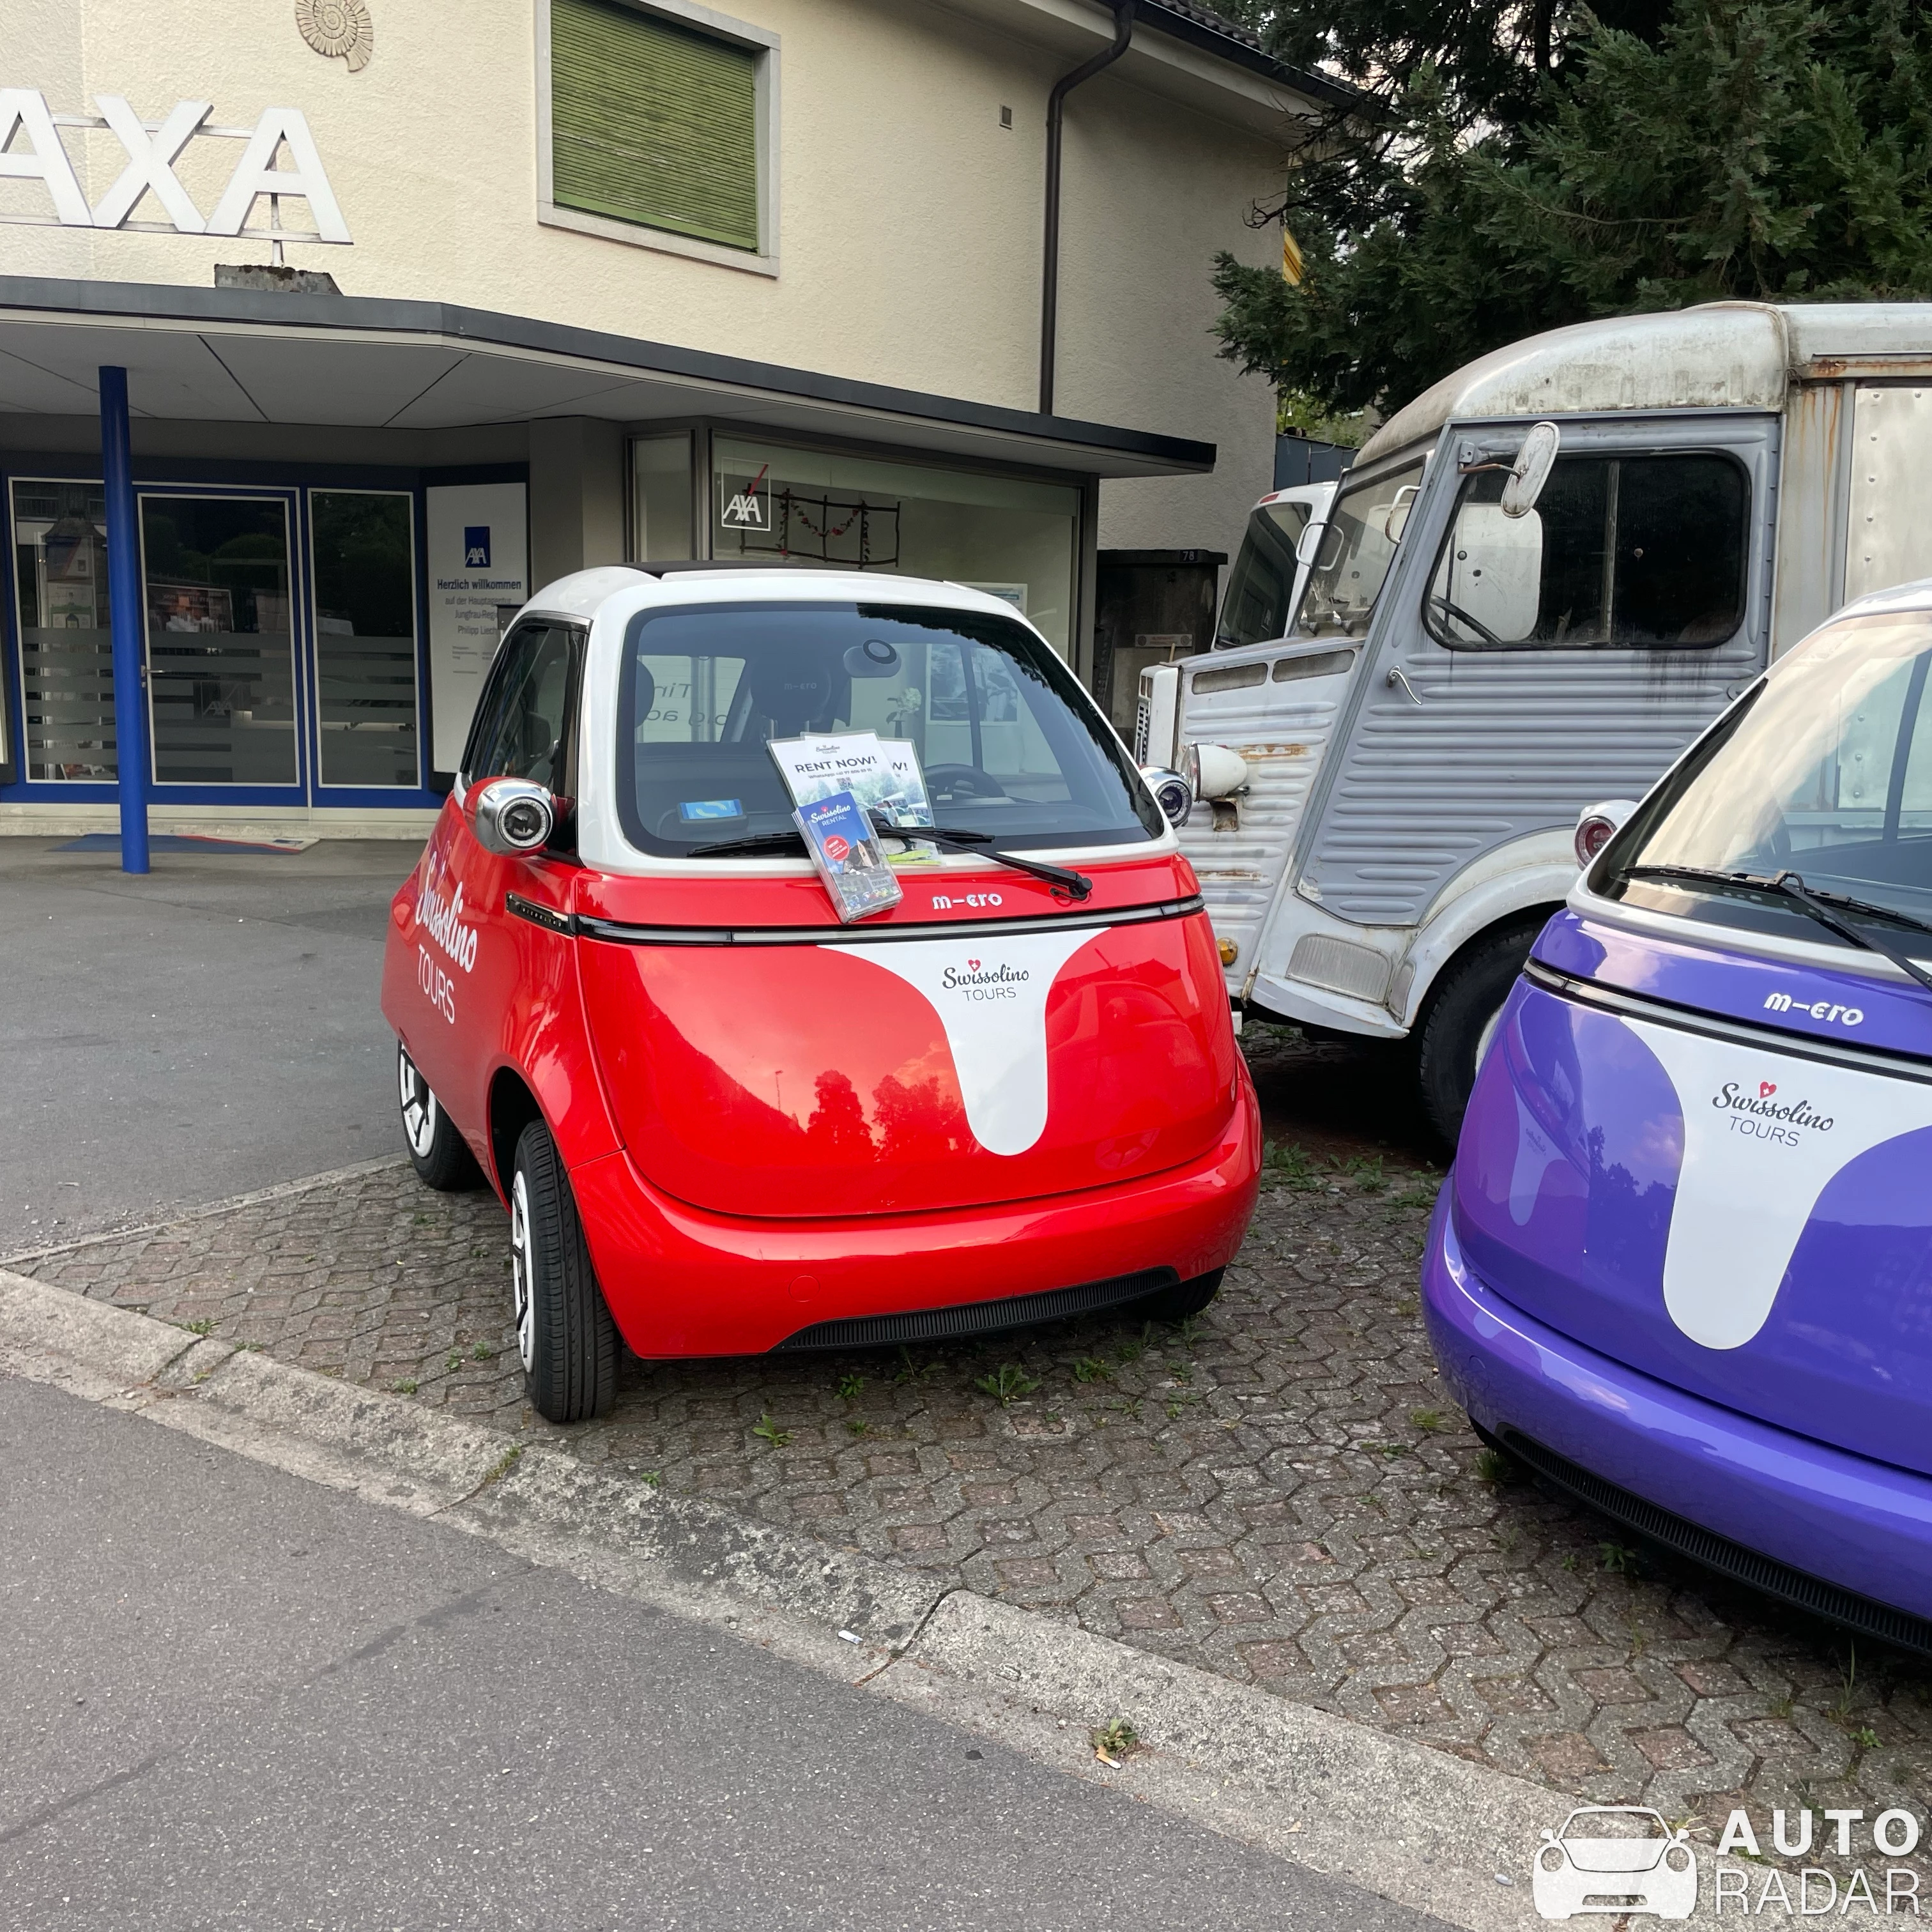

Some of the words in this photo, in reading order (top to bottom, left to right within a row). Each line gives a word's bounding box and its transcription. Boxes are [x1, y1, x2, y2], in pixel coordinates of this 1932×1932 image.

[0, 88, 353, 245] AXA
[723, 494, 762, 523] AXA
[465, 548, 487, 564] AXA
[1183, 551, 1195, 561] 78
[437, 579, 469, 590] Herzlich
[471, 579, 521, 590] willkommen
[794, 761, 832, 773] RENT
[835, 756, 878, 769] NOW!
[811, 804, 851, 824] Swissolino
[822, 815, 847, 826] RENTAL
[418, 944, 455, 1024] TOURS
[942, 963, 1029, 989] Swissolino
[962, 987, 1016, 1001] TOURS
[1712, 1083, 1834, 1131] Swissolino
[1730, 1116, 1800, 1147] TOURS
